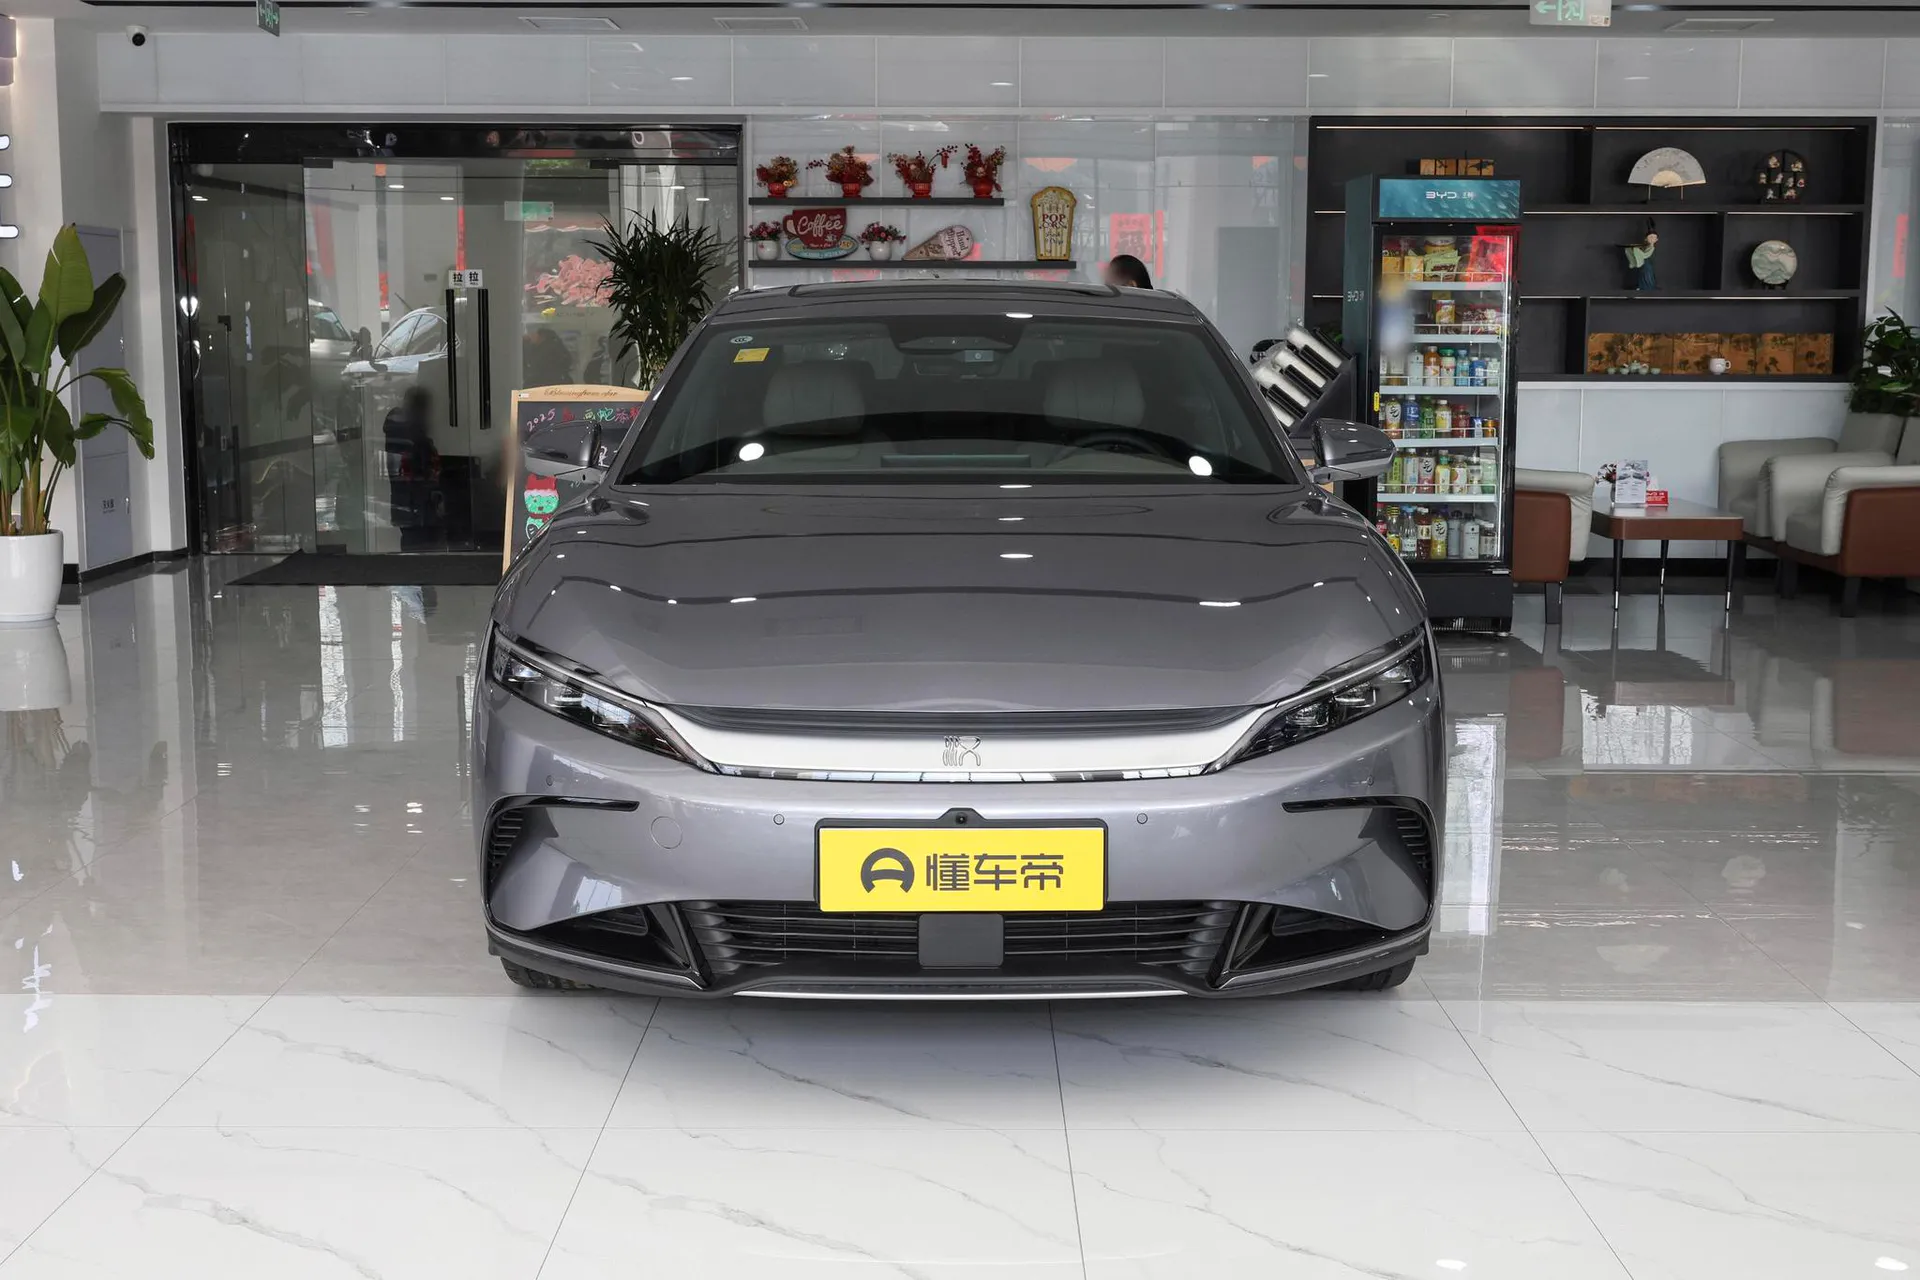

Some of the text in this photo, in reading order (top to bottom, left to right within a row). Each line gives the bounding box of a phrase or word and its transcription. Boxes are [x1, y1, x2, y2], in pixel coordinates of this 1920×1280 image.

[1425, 191, 1457, 199] BYD
[797, 213, 843, 237] Coffee
[1042, 213, 1066, 222] POP
[945, 229, 960, 257] Dipped
[956, 230, 969, 251] Hand
[453, 272, 463, 282] 拉
[469, 271, 479, 281] 拉
[526, 408, 556, 432] 2025
[926, 853, 1064, 891] 懂车帝
